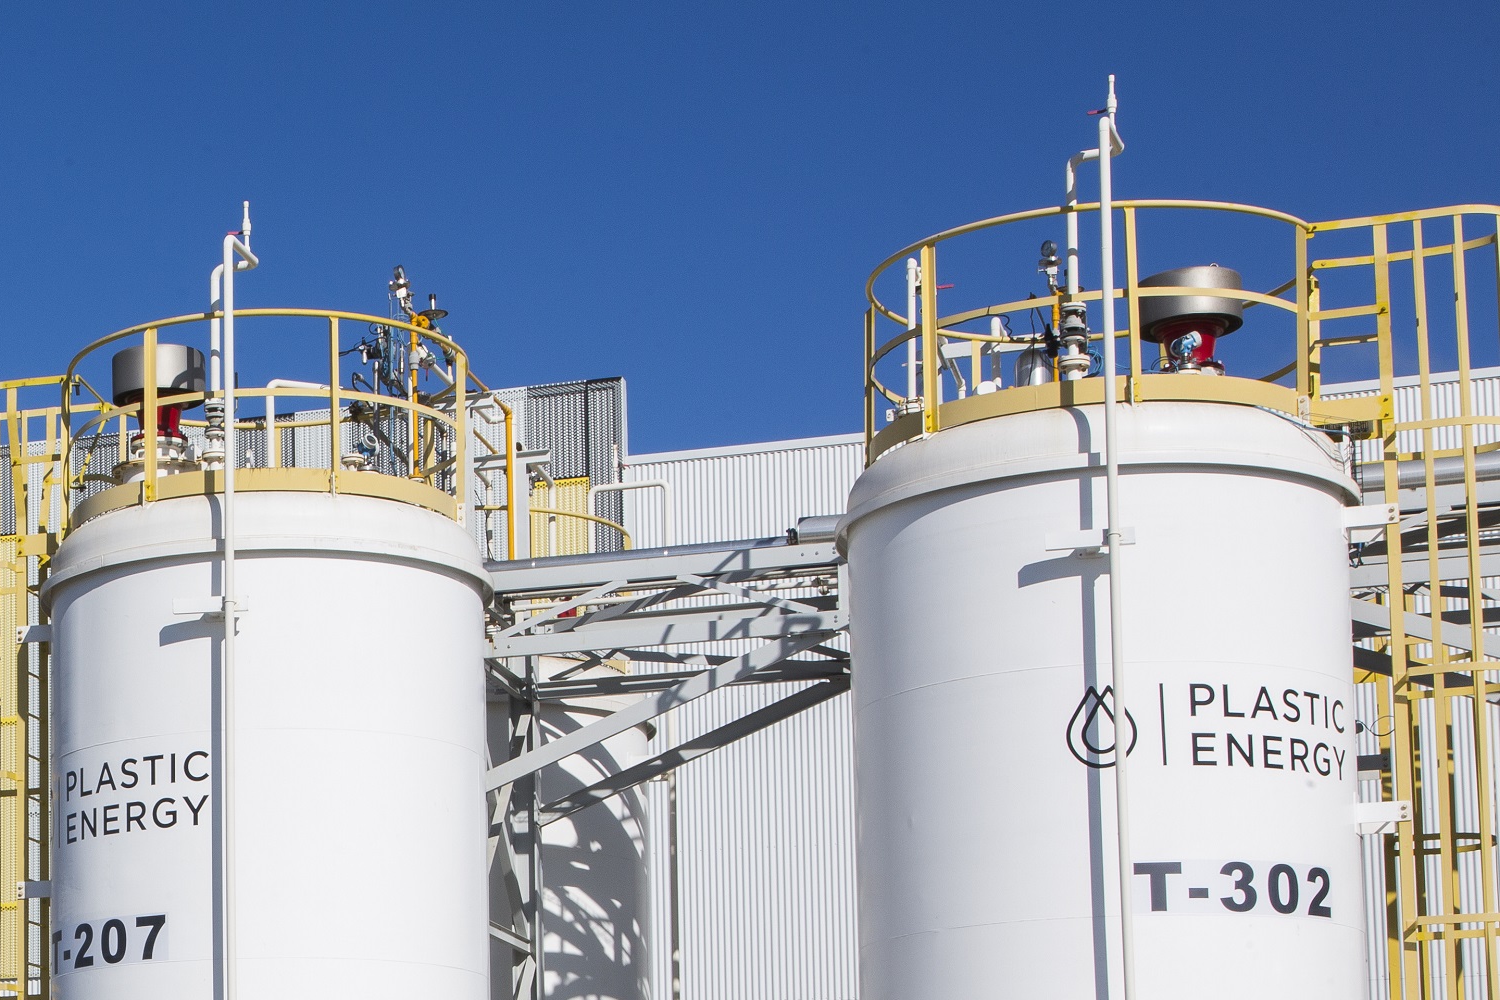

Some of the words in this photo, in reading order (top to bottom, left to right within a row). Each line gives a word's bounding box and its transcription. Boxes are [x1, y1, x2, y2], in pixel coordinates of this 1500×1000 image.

[1189, 683, 1344, 733] PLASTIC
[66, 750, 210, 801] PLASTIC
[1191, 732, 1346, 781] ENERGY
[66, 794, 209, 844] ENERGY
[1133, 861, 1332, 918] T-302
